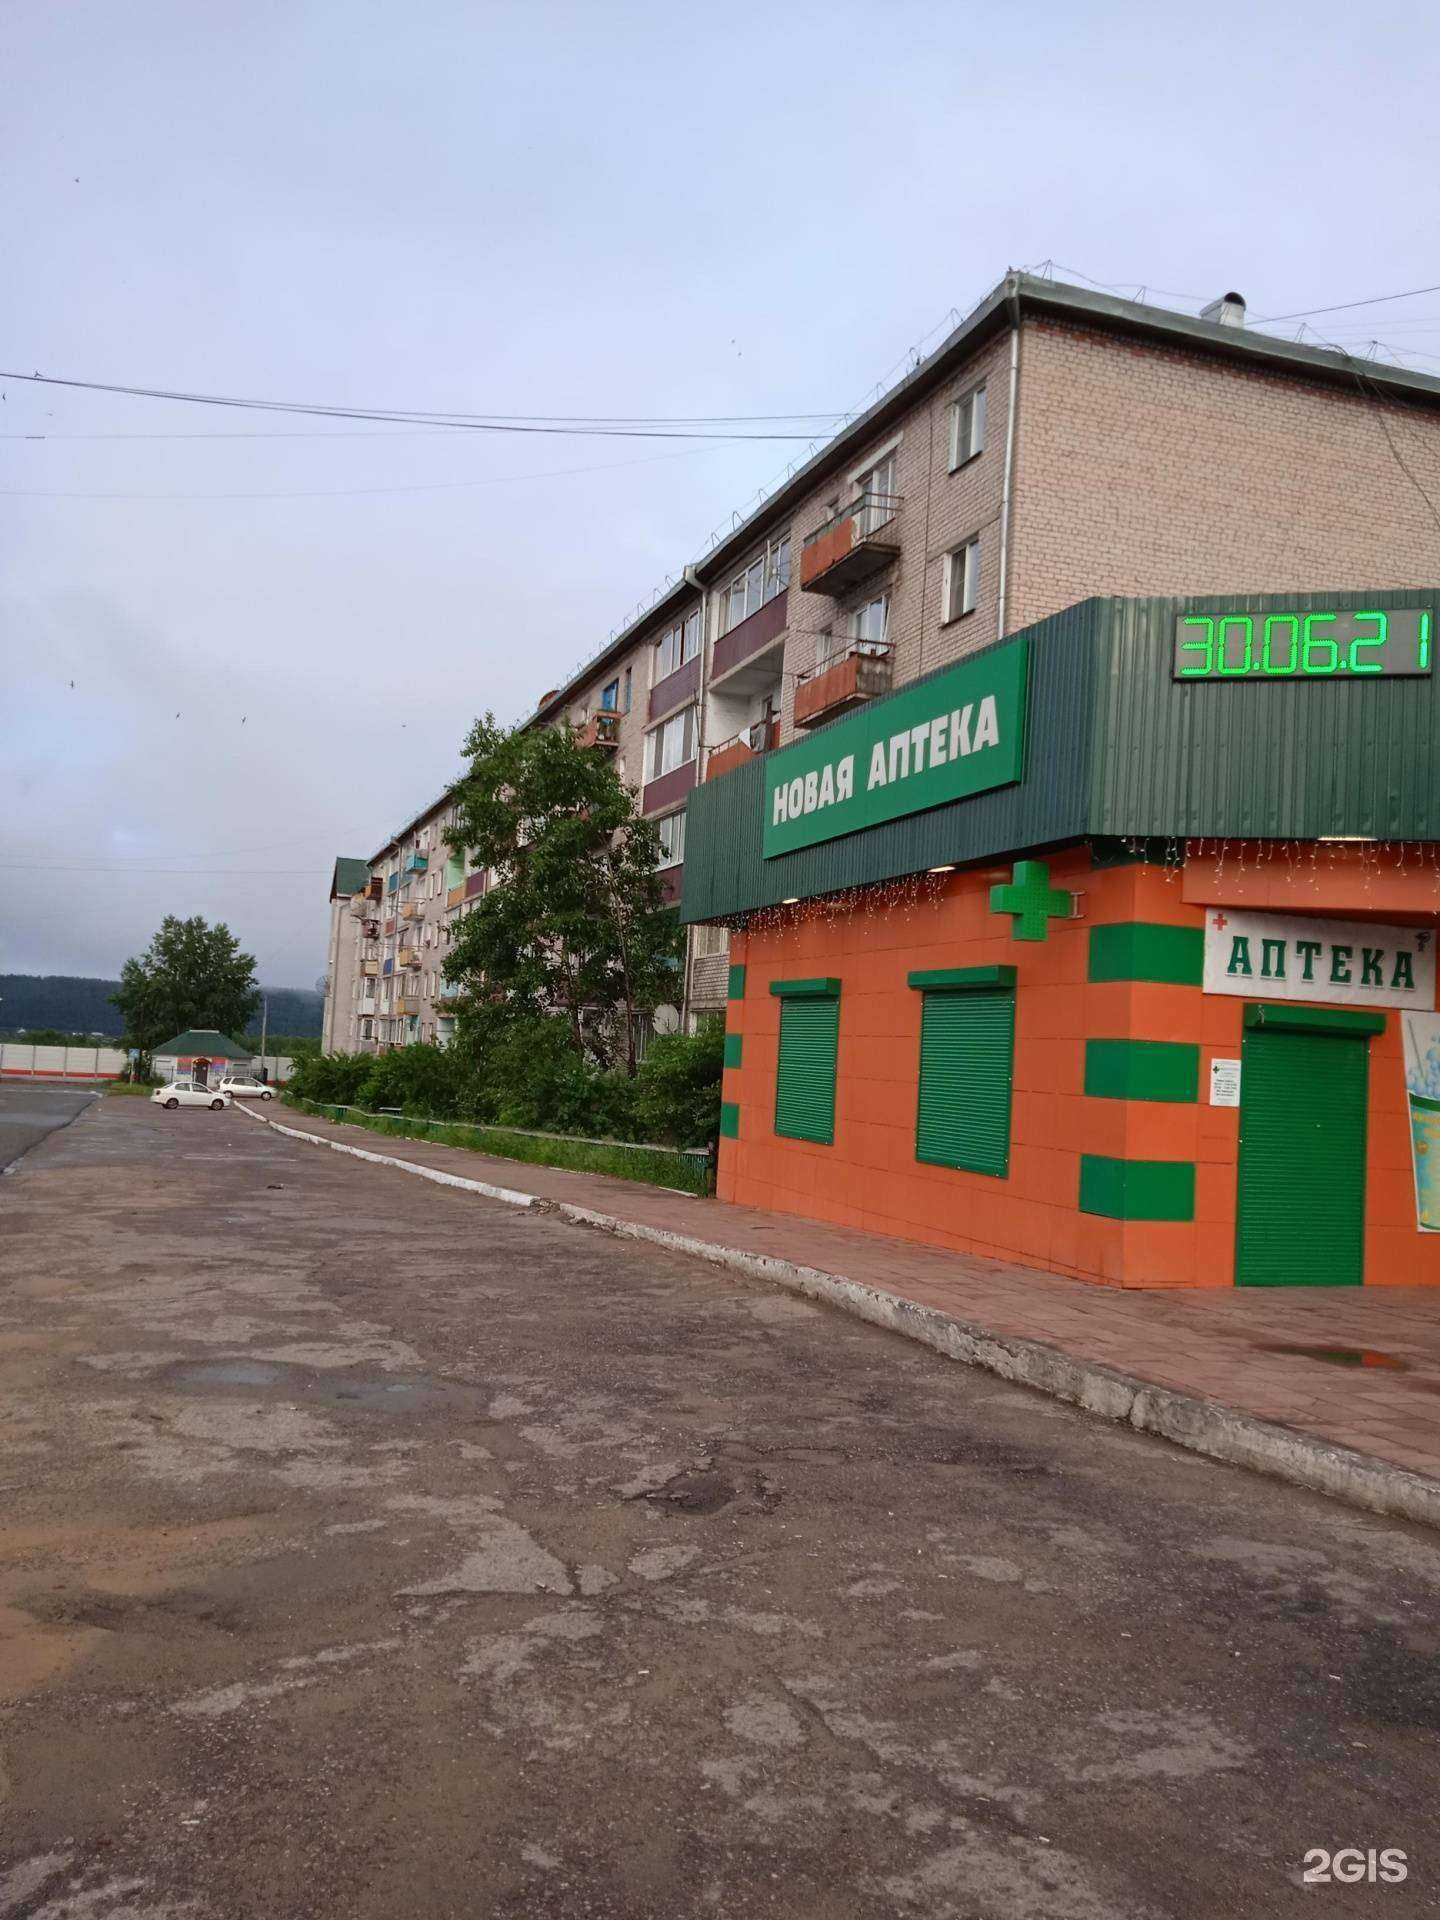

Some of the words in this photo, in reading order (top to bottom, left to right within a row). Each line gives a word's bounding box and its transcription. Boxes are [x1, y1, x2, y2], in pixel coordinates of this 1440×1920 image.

[1181, 611, 1430, 676] 30.06.21
[772, 754, 855, 827] НОВАЯ
[866, 694, 1000, 792] АПТЕКА
[1225, 935, 1417, 991] АПТЕКА
